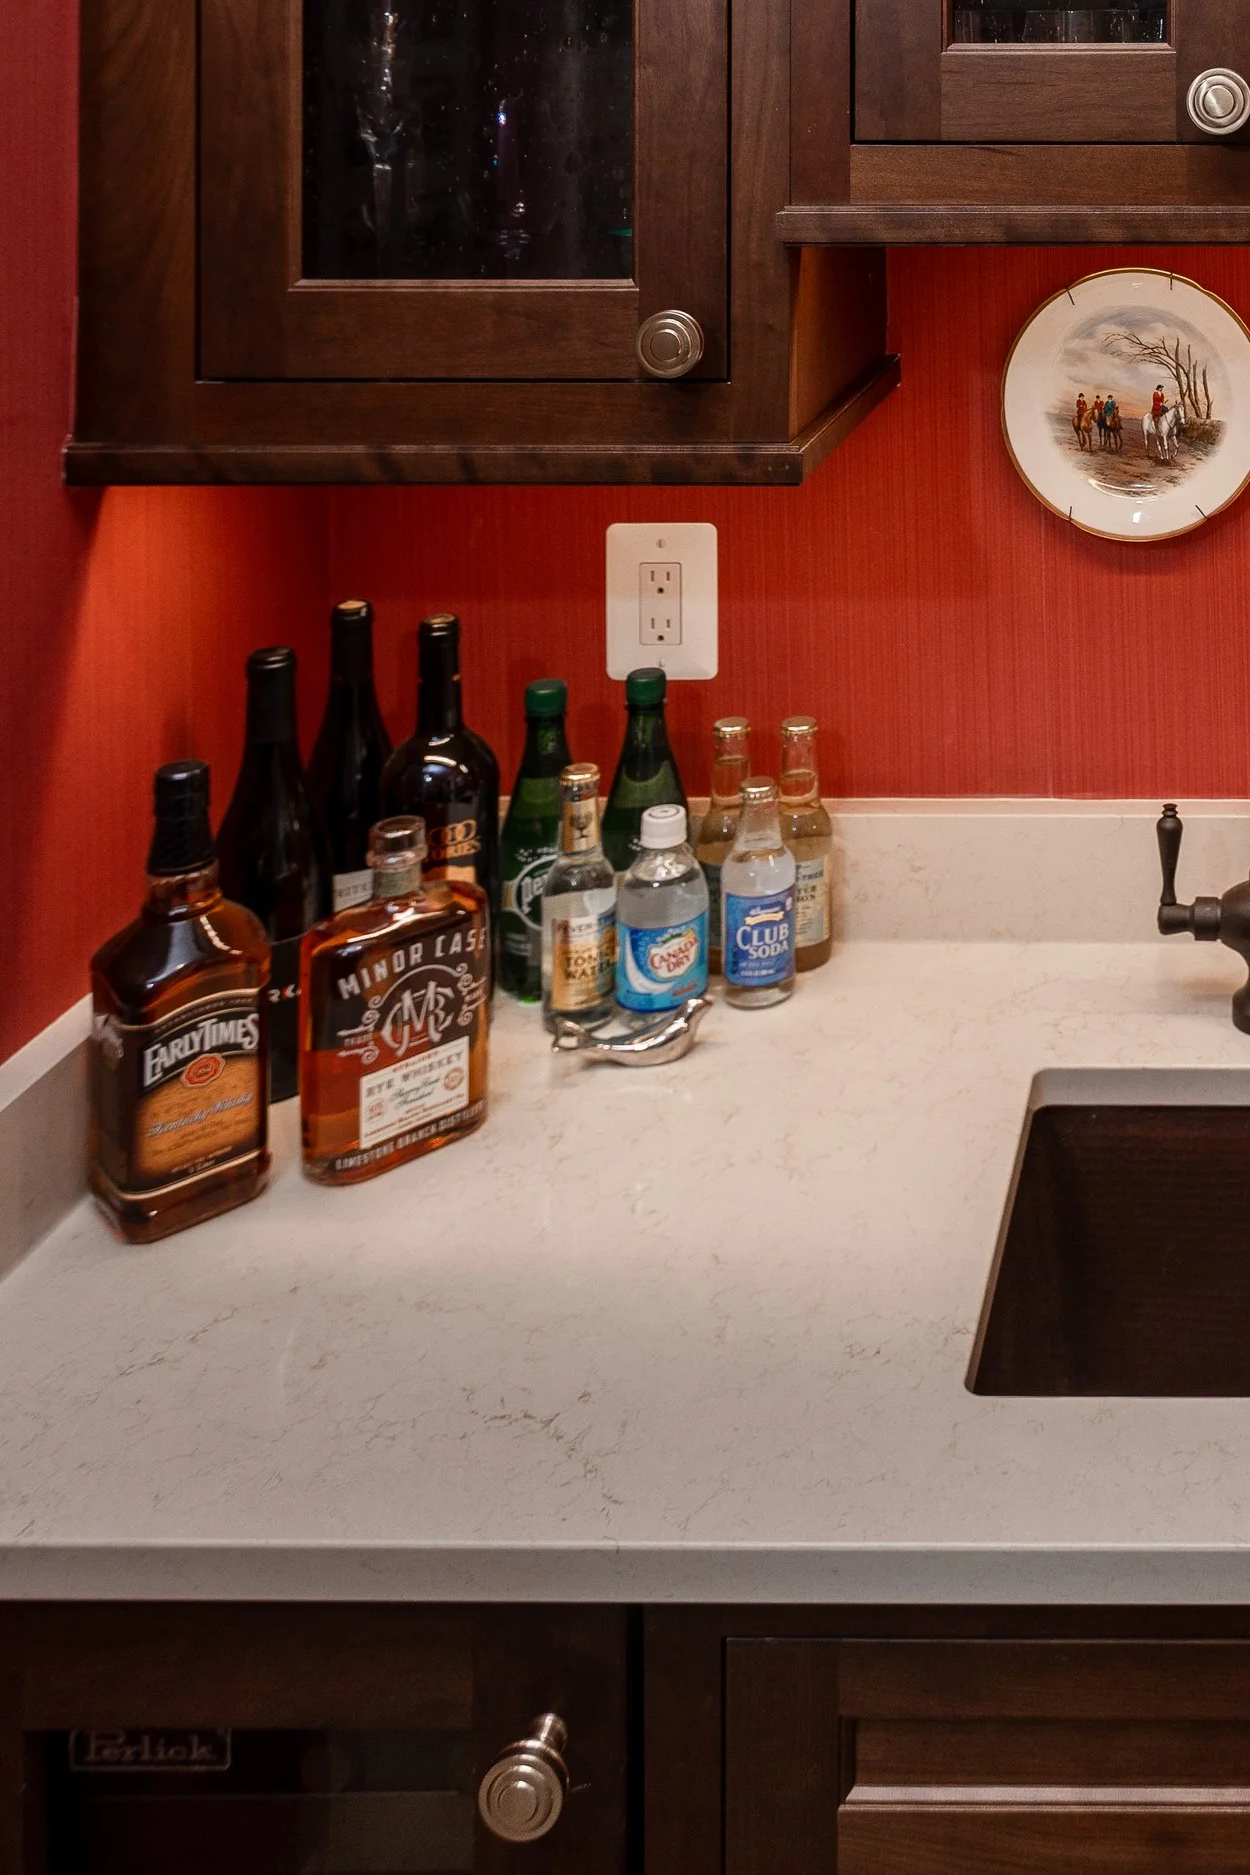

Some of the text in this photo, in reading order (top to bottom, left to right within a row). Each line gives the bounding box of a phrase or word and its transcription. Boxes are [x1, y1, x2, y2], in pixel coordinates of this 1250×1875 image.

[736, 923, 789, 950] CLUB
[748, 940, 788, 960] SODA
[337, 942, 423, 1000] MINOR
[434, 926, 488, 958] CASE
[650, 936, 698, 970] CANADA
[667, 954, 690, 973] DRY
[84, 1728, 219, 1762] Perlick
